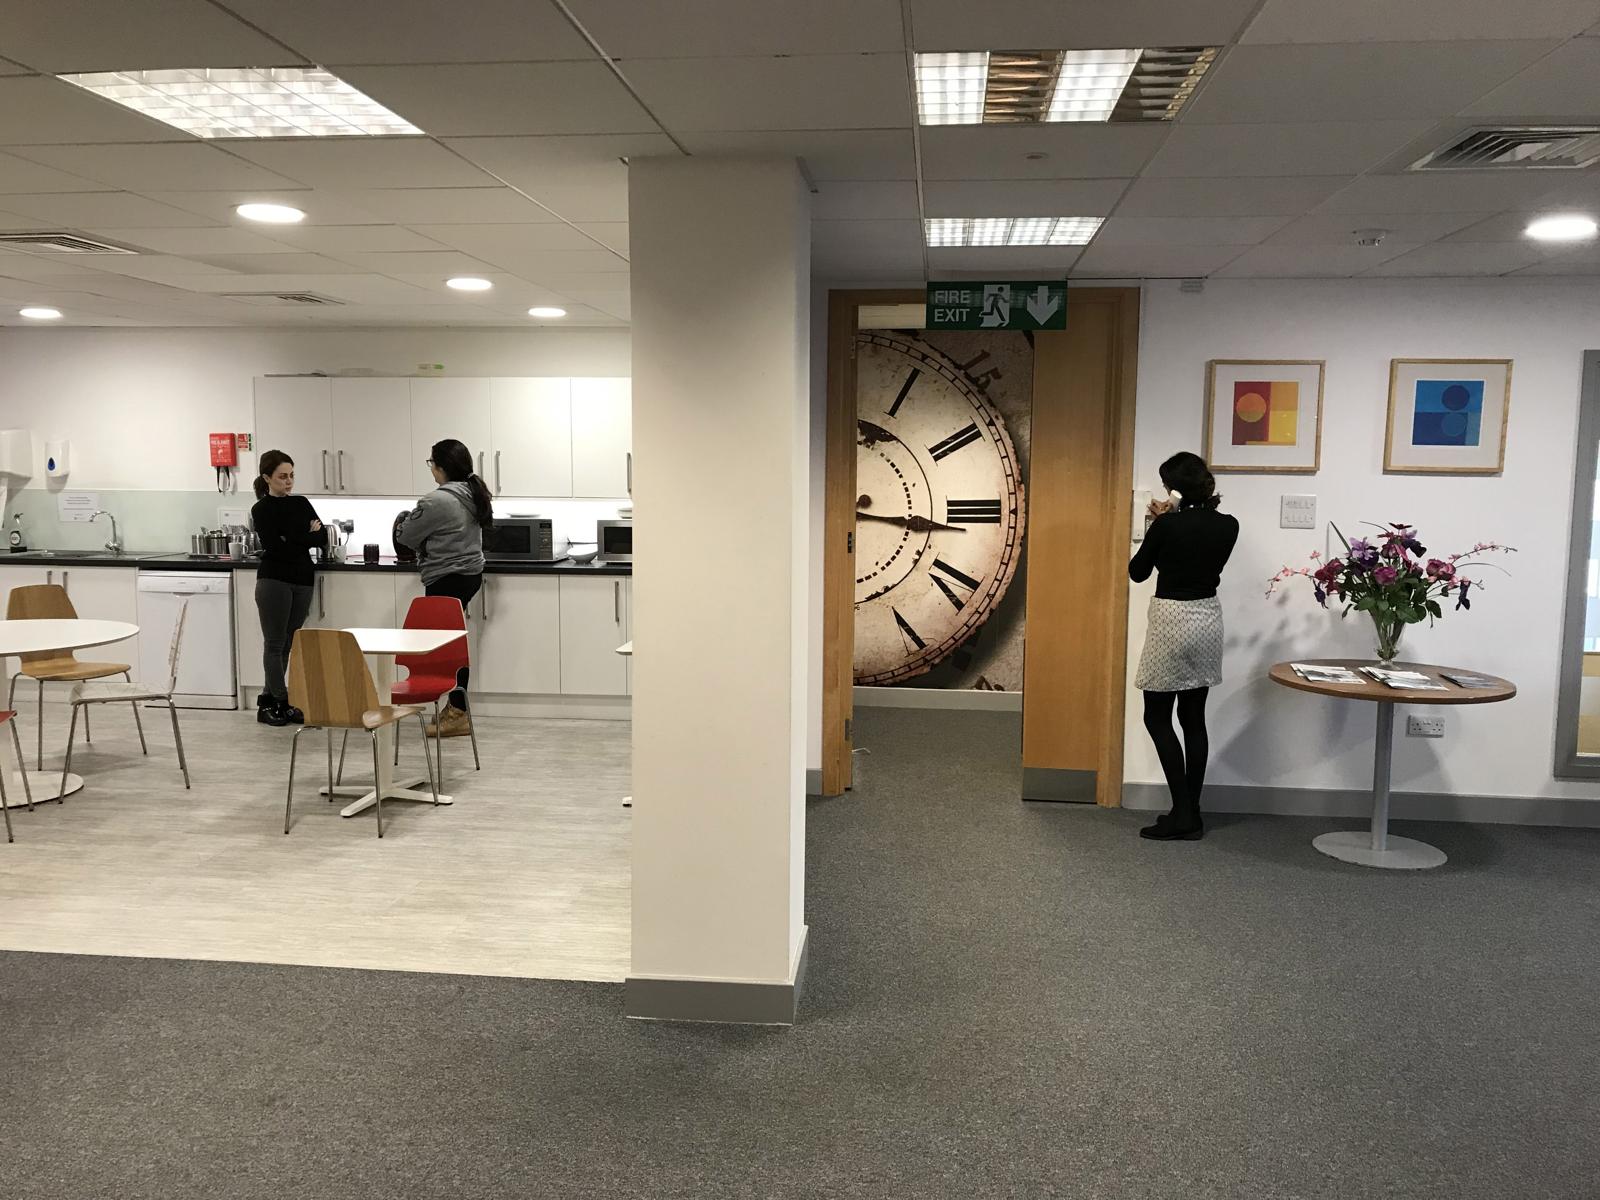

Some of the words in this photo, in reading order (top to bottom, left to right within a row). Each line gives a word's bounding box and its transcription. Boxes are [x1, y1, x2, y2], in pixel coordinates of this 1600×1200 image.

[934, 290, 971, 304] FIRE
[934, 308, 971, 322] EXIT
[924, 415, 986, 467] II
[946, 494, 1002, 528] III
